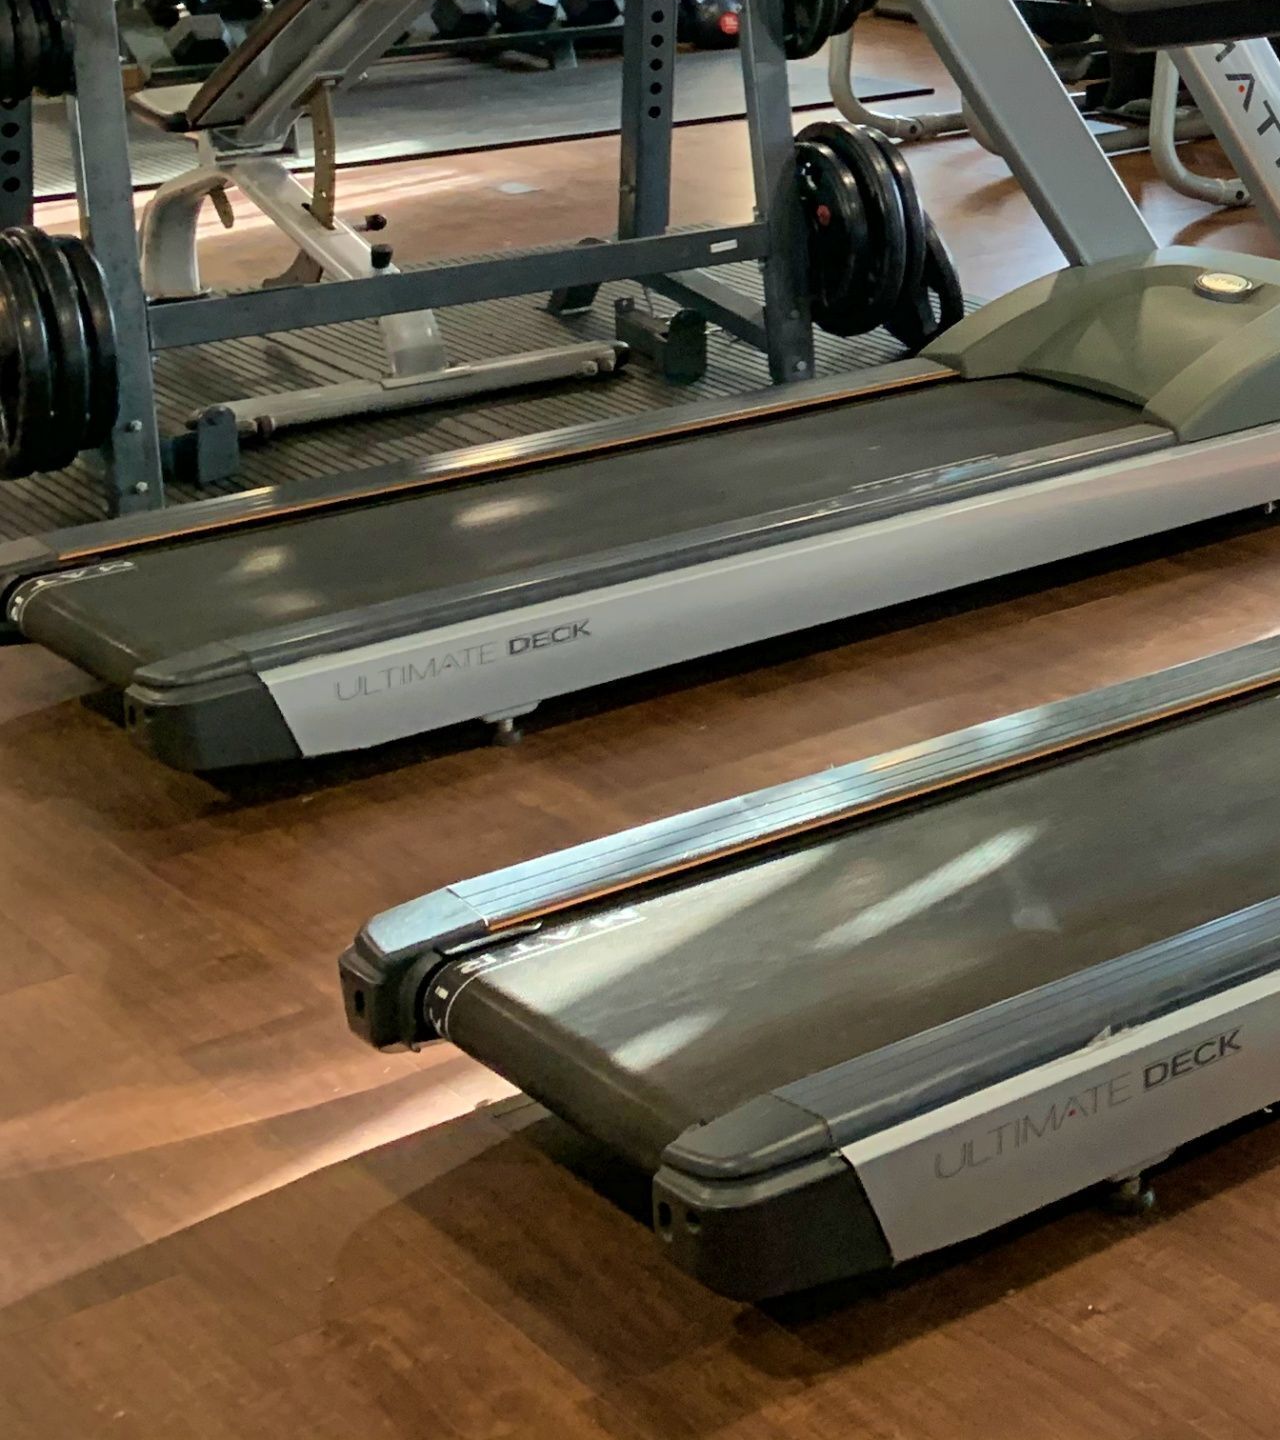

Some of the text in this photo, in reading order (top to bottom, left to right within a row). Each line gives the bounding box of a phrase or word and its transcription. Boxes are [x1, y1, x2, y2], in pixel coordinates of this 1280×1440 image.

[334, 618, 592, 702] ULTIMATE DECK
[934, 1027, 1243, 1180] ULTIMATE DECK
